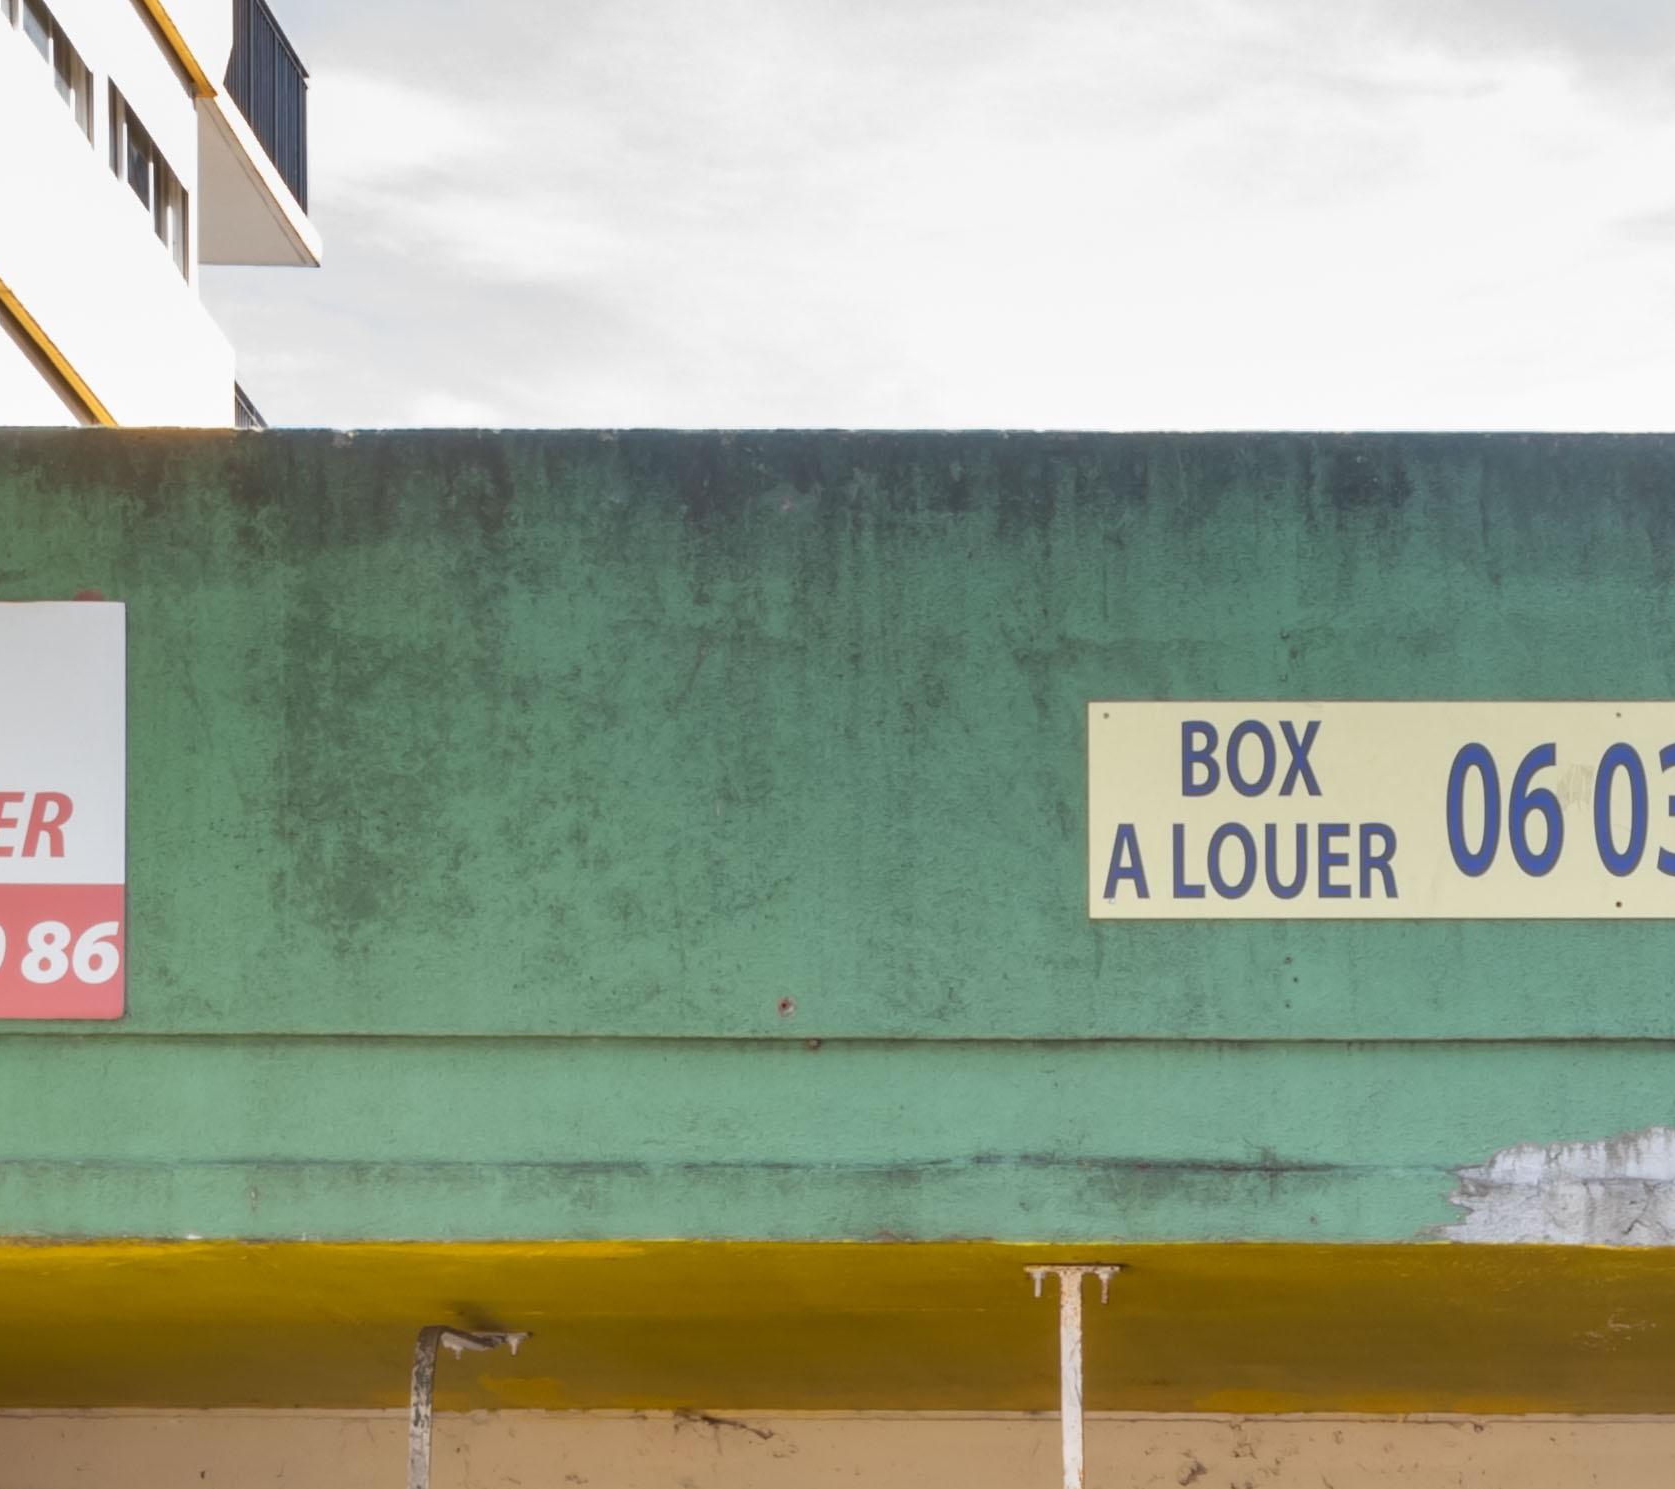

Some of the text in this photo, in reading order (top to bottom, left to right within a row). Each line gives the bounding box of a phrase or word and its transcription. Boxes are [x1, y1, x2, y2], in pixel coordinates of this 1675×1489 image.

[1180, 719, 1323, 798] BOX
[1445, 741, 1565, 878] 06
[1103, 822, 1399, 900] A LOUER
[20, 921, 121, 984] 86
